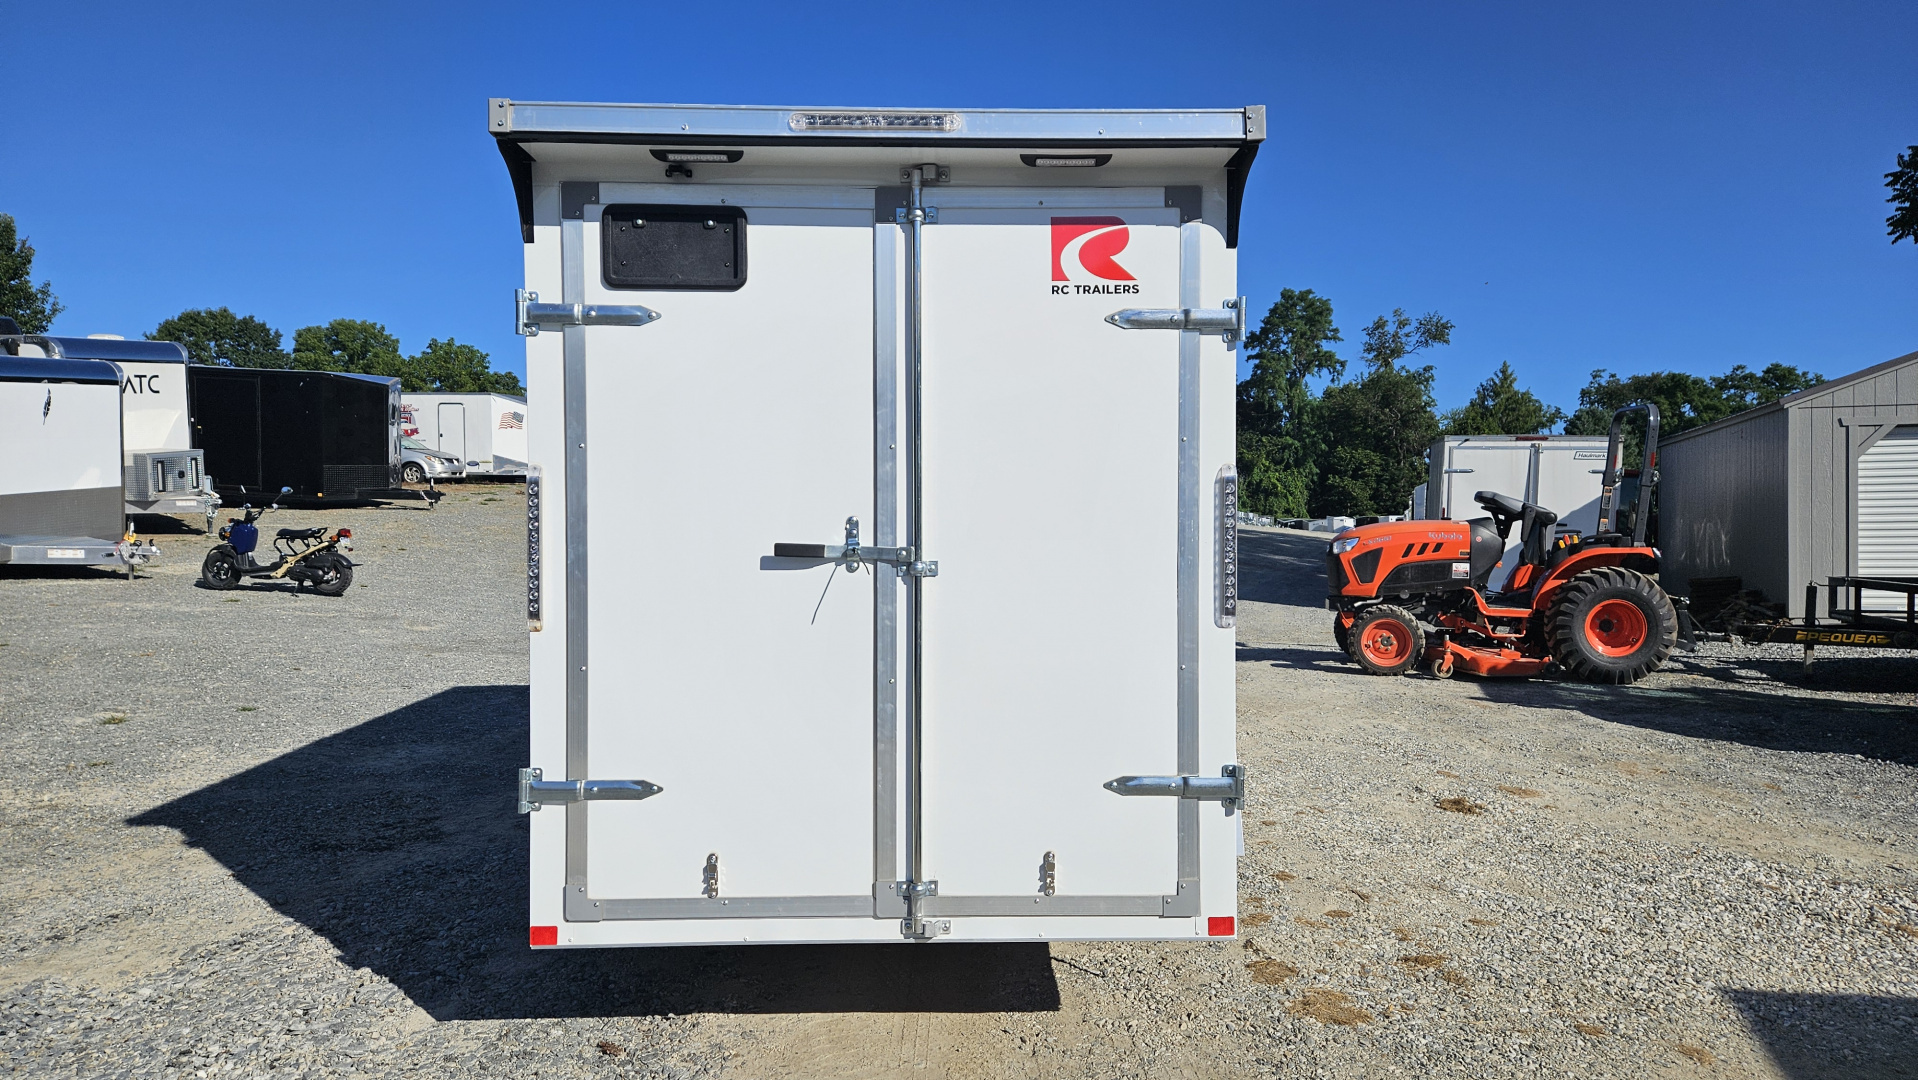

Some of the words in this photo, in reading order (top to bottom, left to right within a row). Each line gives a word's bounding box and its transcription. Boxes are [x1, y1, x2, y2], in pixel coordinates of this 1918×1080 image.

[1051, 285, 1070, 295] RC
[1074, 284, 1140, 295] TRAILERS
[122, 374, 160, 394] ATC
[1428, 531, 1463, 541] Kubota
[1806, 631, 1877, 644] PEQUEA
